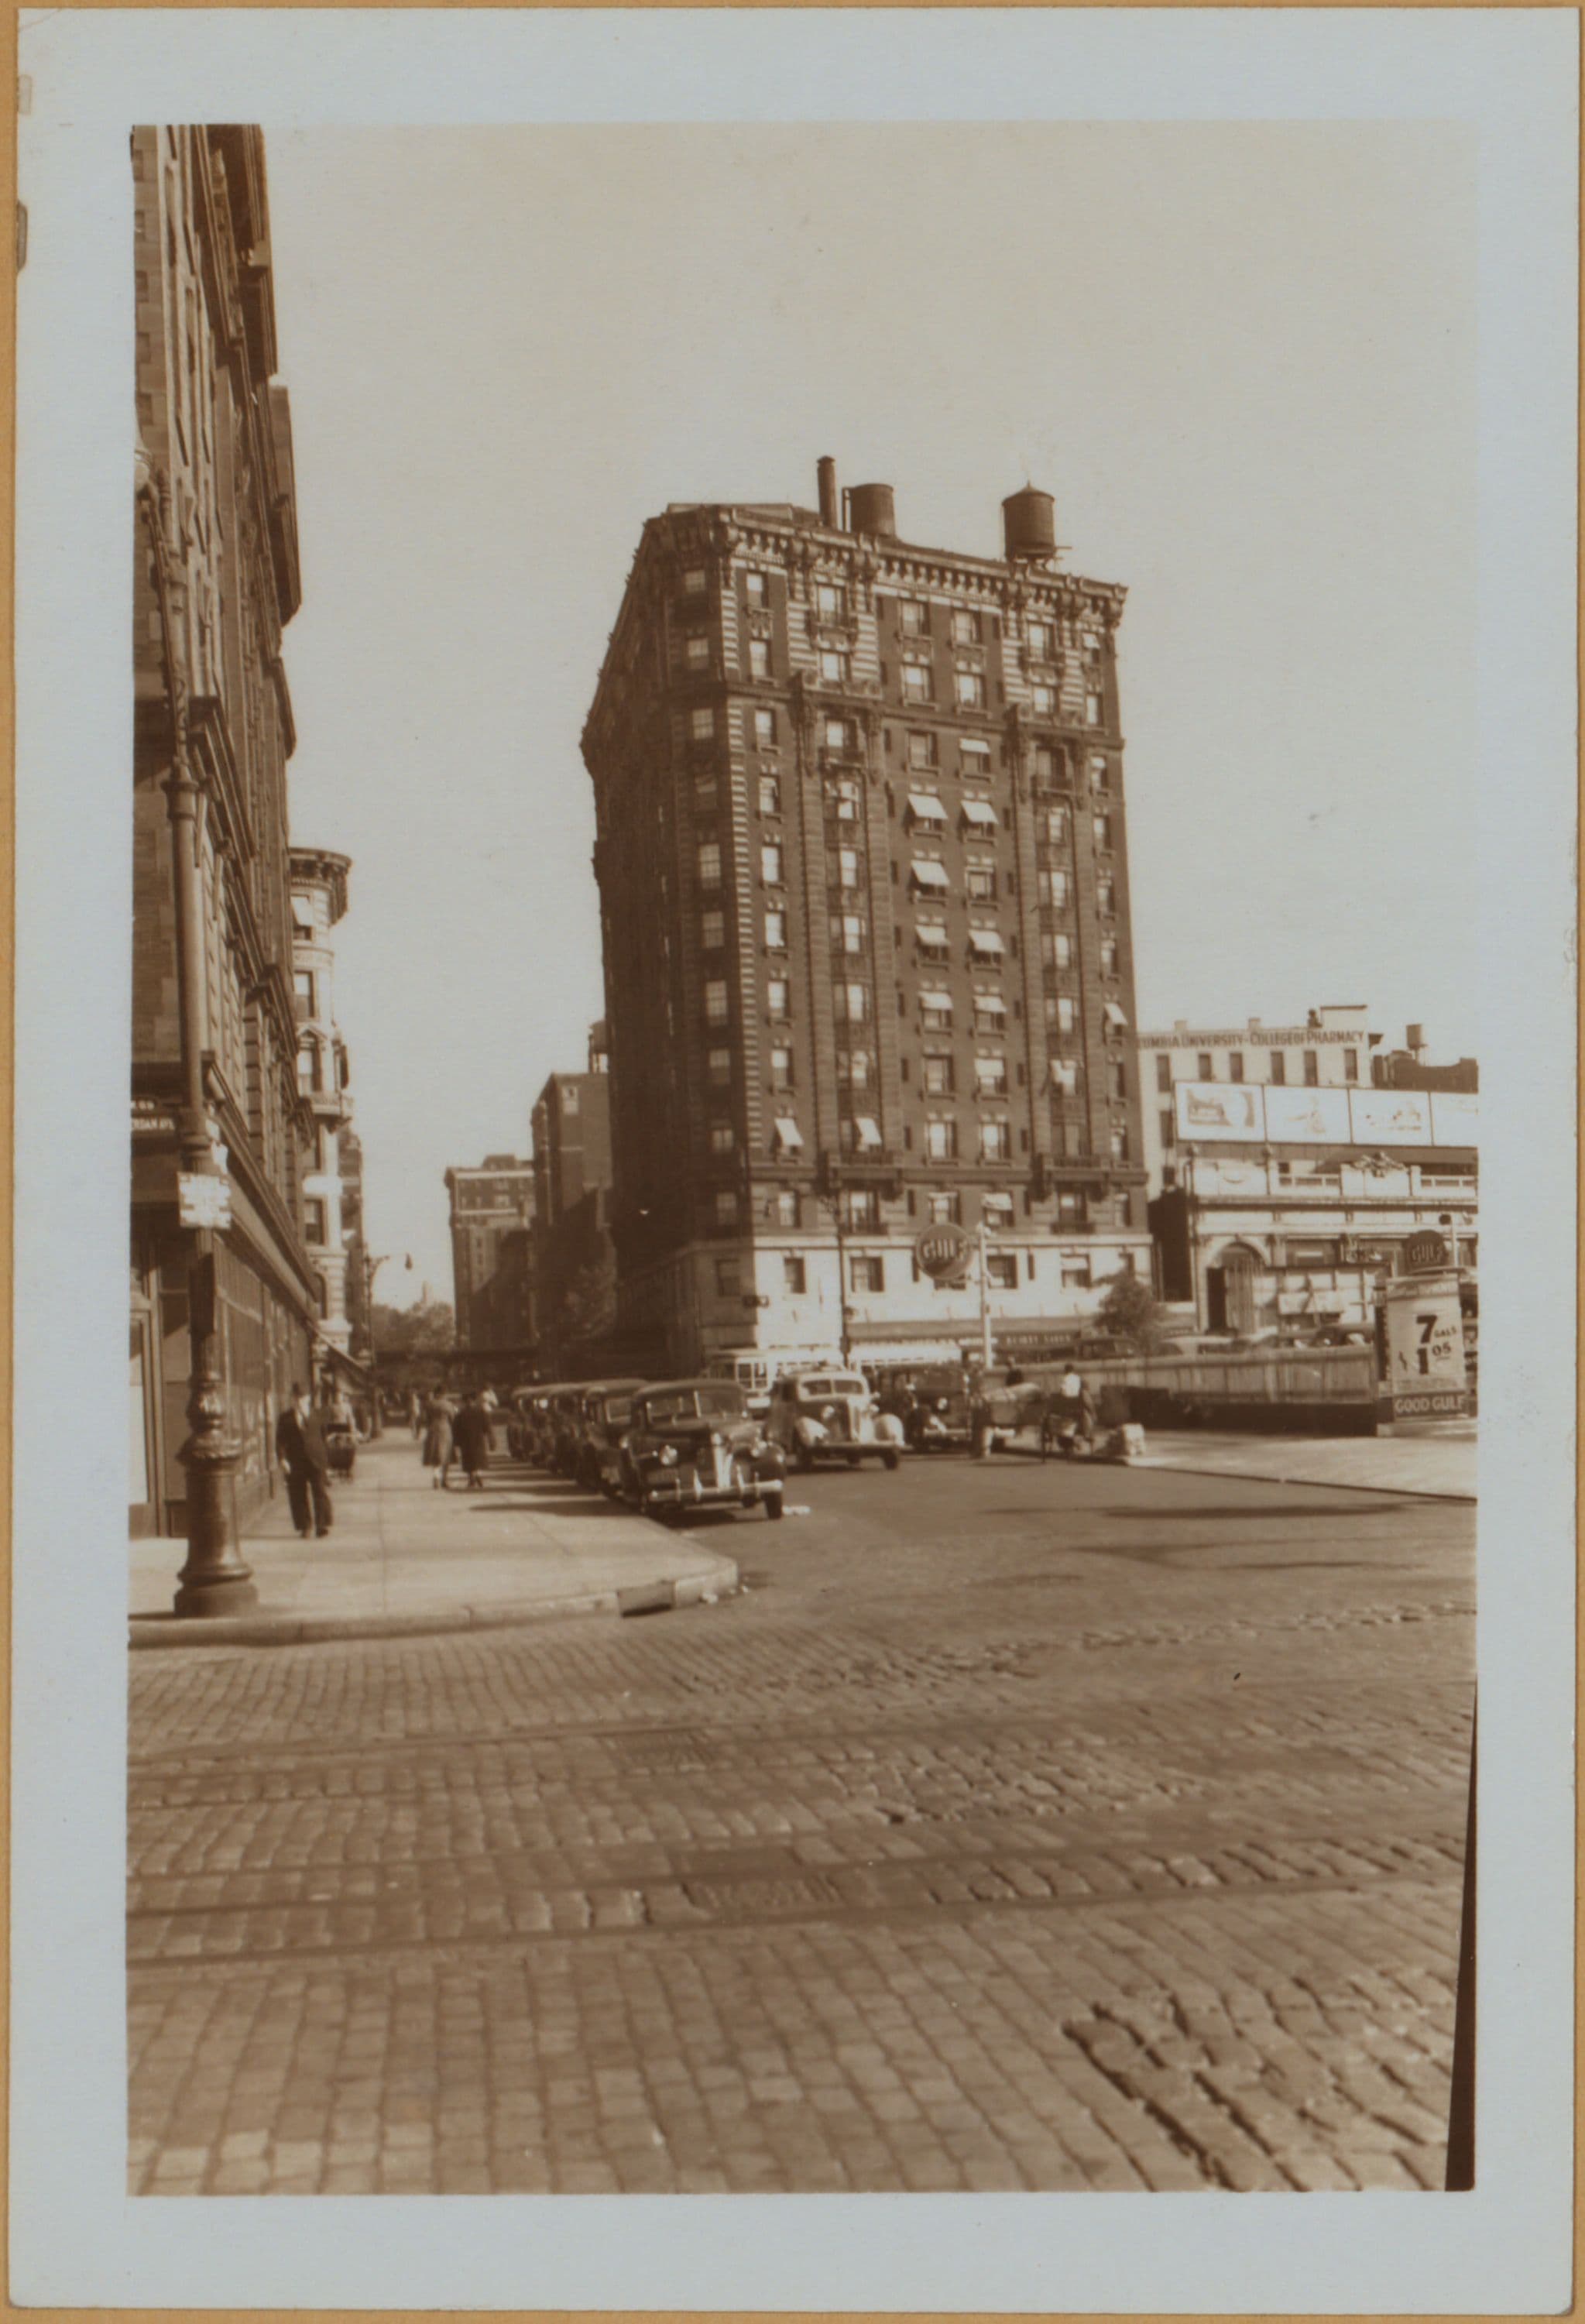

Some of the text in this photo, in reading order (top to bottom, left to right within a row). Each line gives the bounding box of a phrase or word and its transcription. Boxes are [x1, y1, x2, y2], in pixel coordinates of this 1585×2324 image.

[1182, 1032, 1242, 1047] UNIVERSITY
[1250, 1032, 1292, 1045] COLLEGE
[1306, 1030, 1364, 1044] PHARMACY
[922, 1238, 966, 1261] GULF
[1412, 1244, 1442, 1264] GULF
[1416, 1315, 1438, 1344] 7
[1395, 1395, 1465, 1413] GOOD GULF
